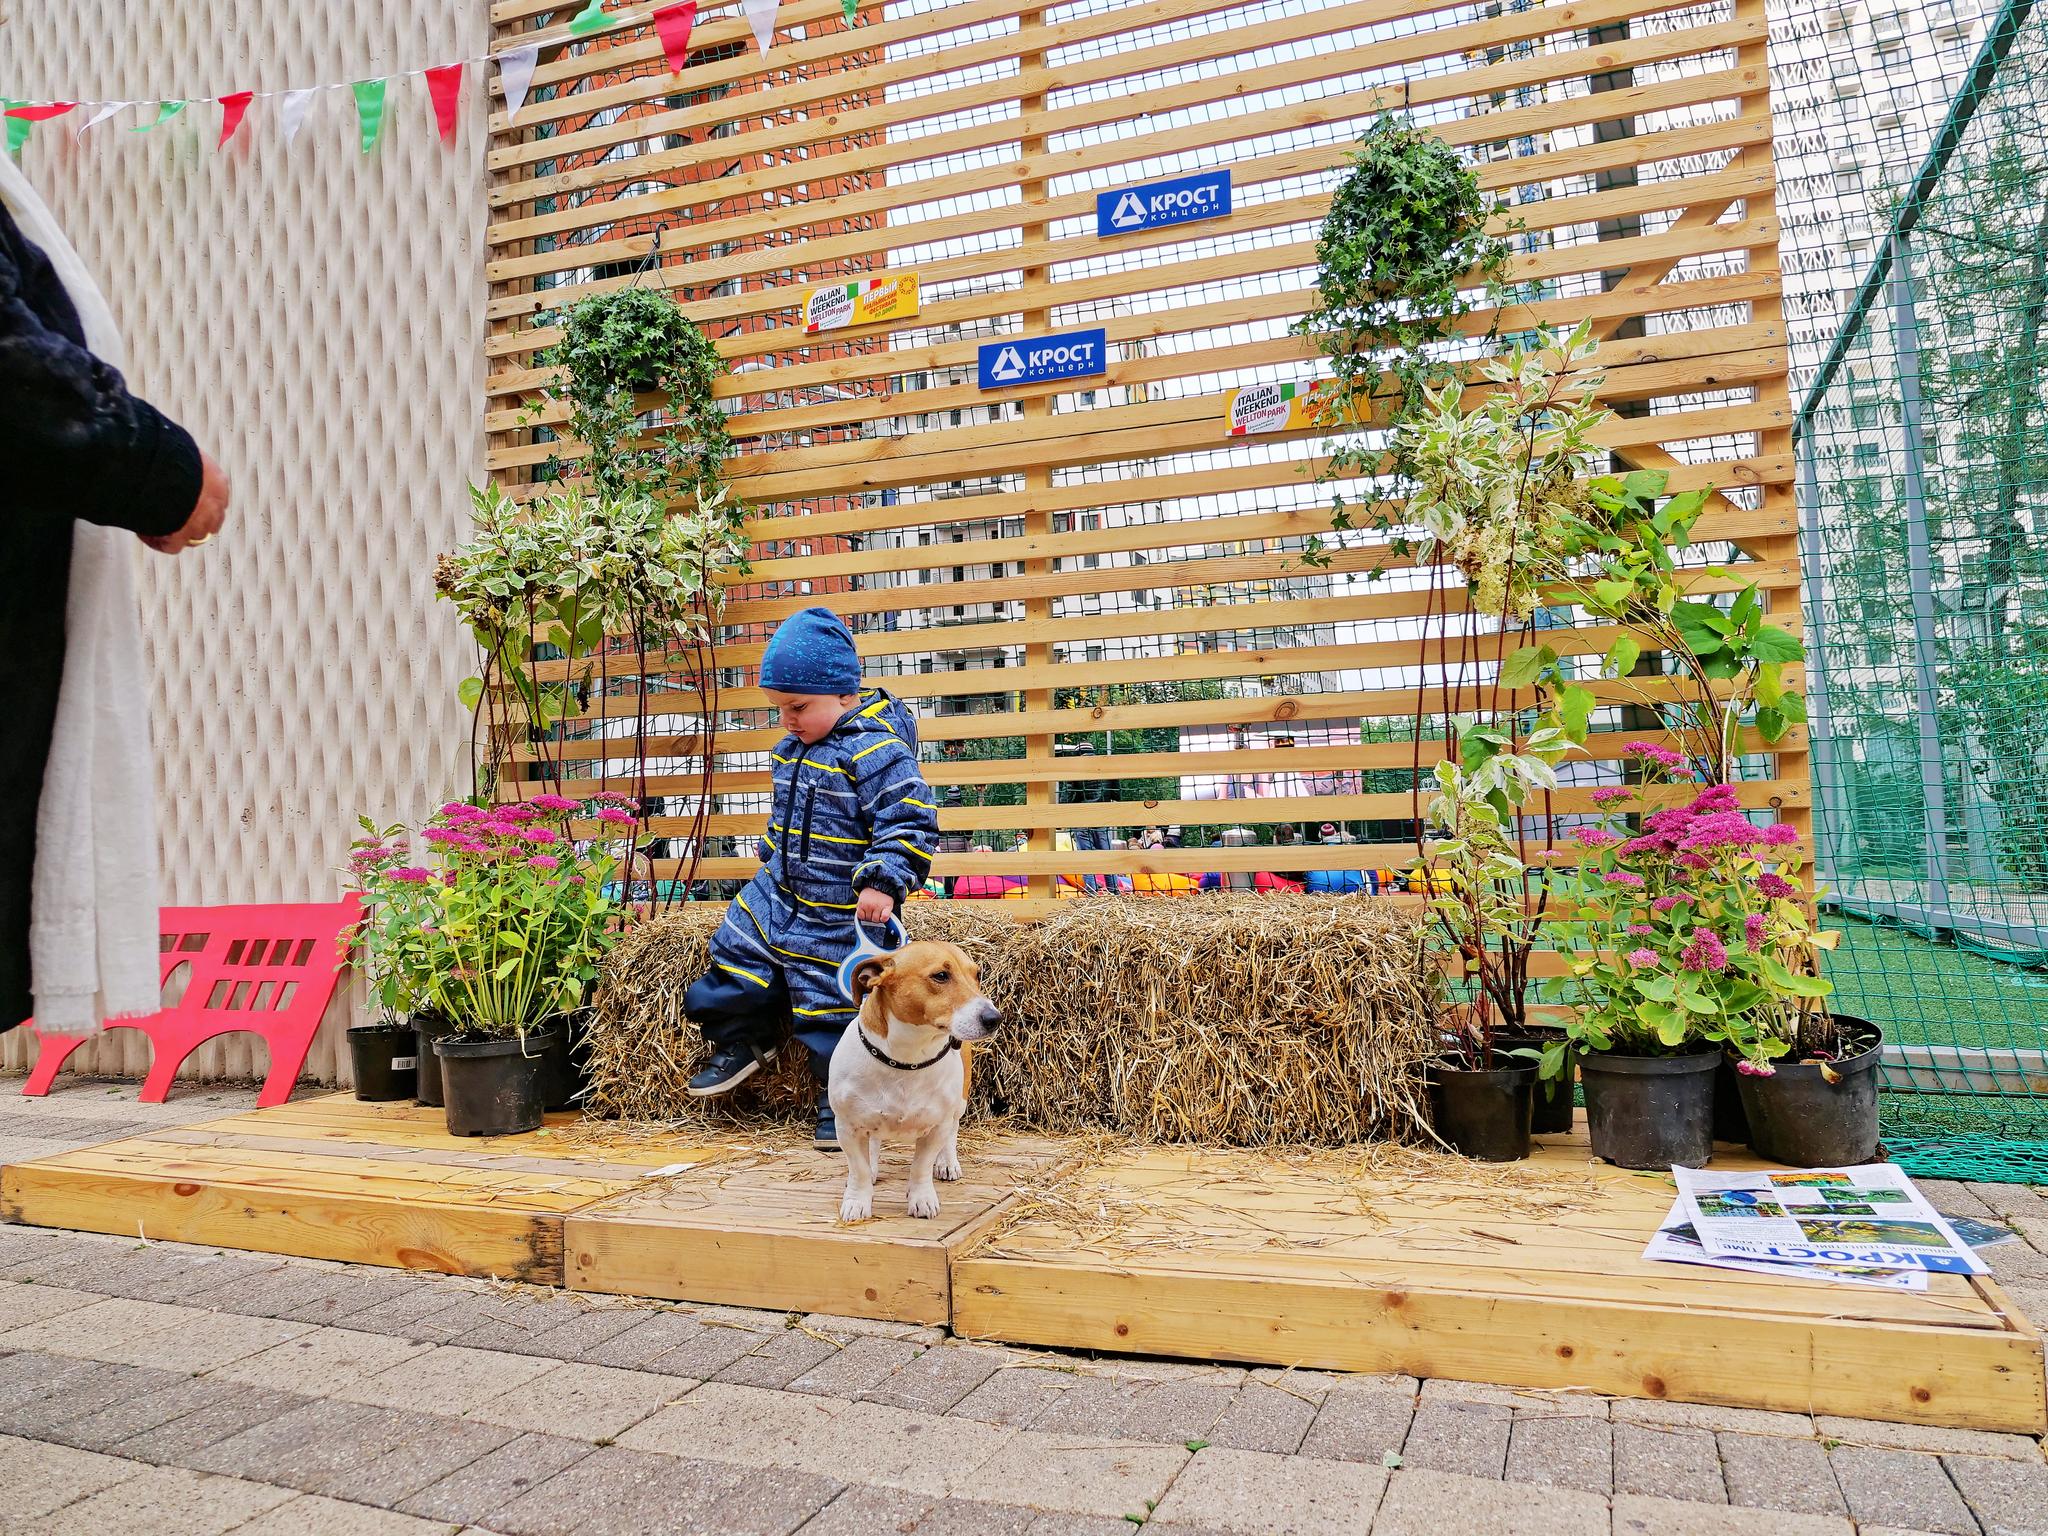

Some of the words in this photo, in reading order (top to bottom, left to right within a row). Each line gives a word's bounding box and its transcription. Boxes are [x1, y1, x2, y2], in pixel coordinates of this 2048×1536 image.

[1150, 185, 1219, 213] КРОСТ
[1151, 203, 1219, 221] концерн
[812, 287, 841, 307] ITALIAN
[863, 279, 898, 305] ПЕРВЫЙ
[810, 294, 846, 316] WEEKEND
[810, 307, 836, 324] WELLTON
[835, 302, 852, 317] PARK
[1029, 342, 1095, 368] КРОСТ
[1030, 361, 1094, 376] концерн
[1235, 394, 1279, 417] WEEKEND
[1237, 386, 1273, 407] ITALIAN
[1235, 408, 1267, 427] WELLTON
[1266, 404, 1287, 419] PARK
[1763, 1247, 1918, 1264] КРОСТ
